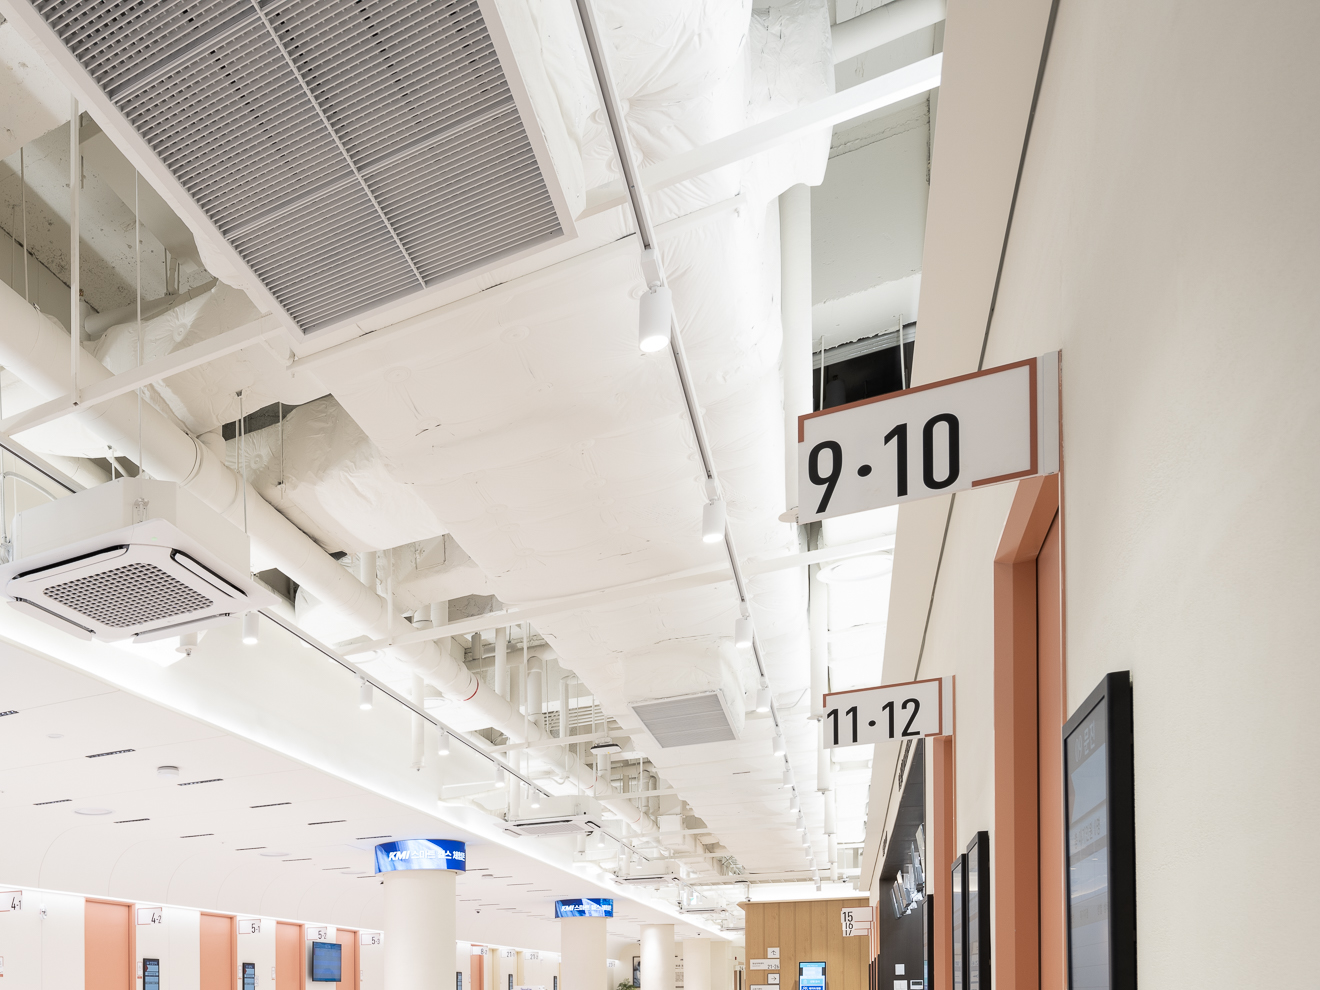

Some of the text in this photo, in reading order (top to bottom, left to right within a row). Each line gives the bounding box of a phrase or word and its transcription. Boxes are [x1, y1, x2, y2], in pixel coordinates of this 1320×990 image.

[388, 850, 411, 861] KMI
[411, 849, 435, 859] 스마트
[10, 896, 21, 910] 4-1
[151, 912, 162, 924] 4-2
[842, 911, 854, 922] 15
[251, 922, 260, 934] 5-1
